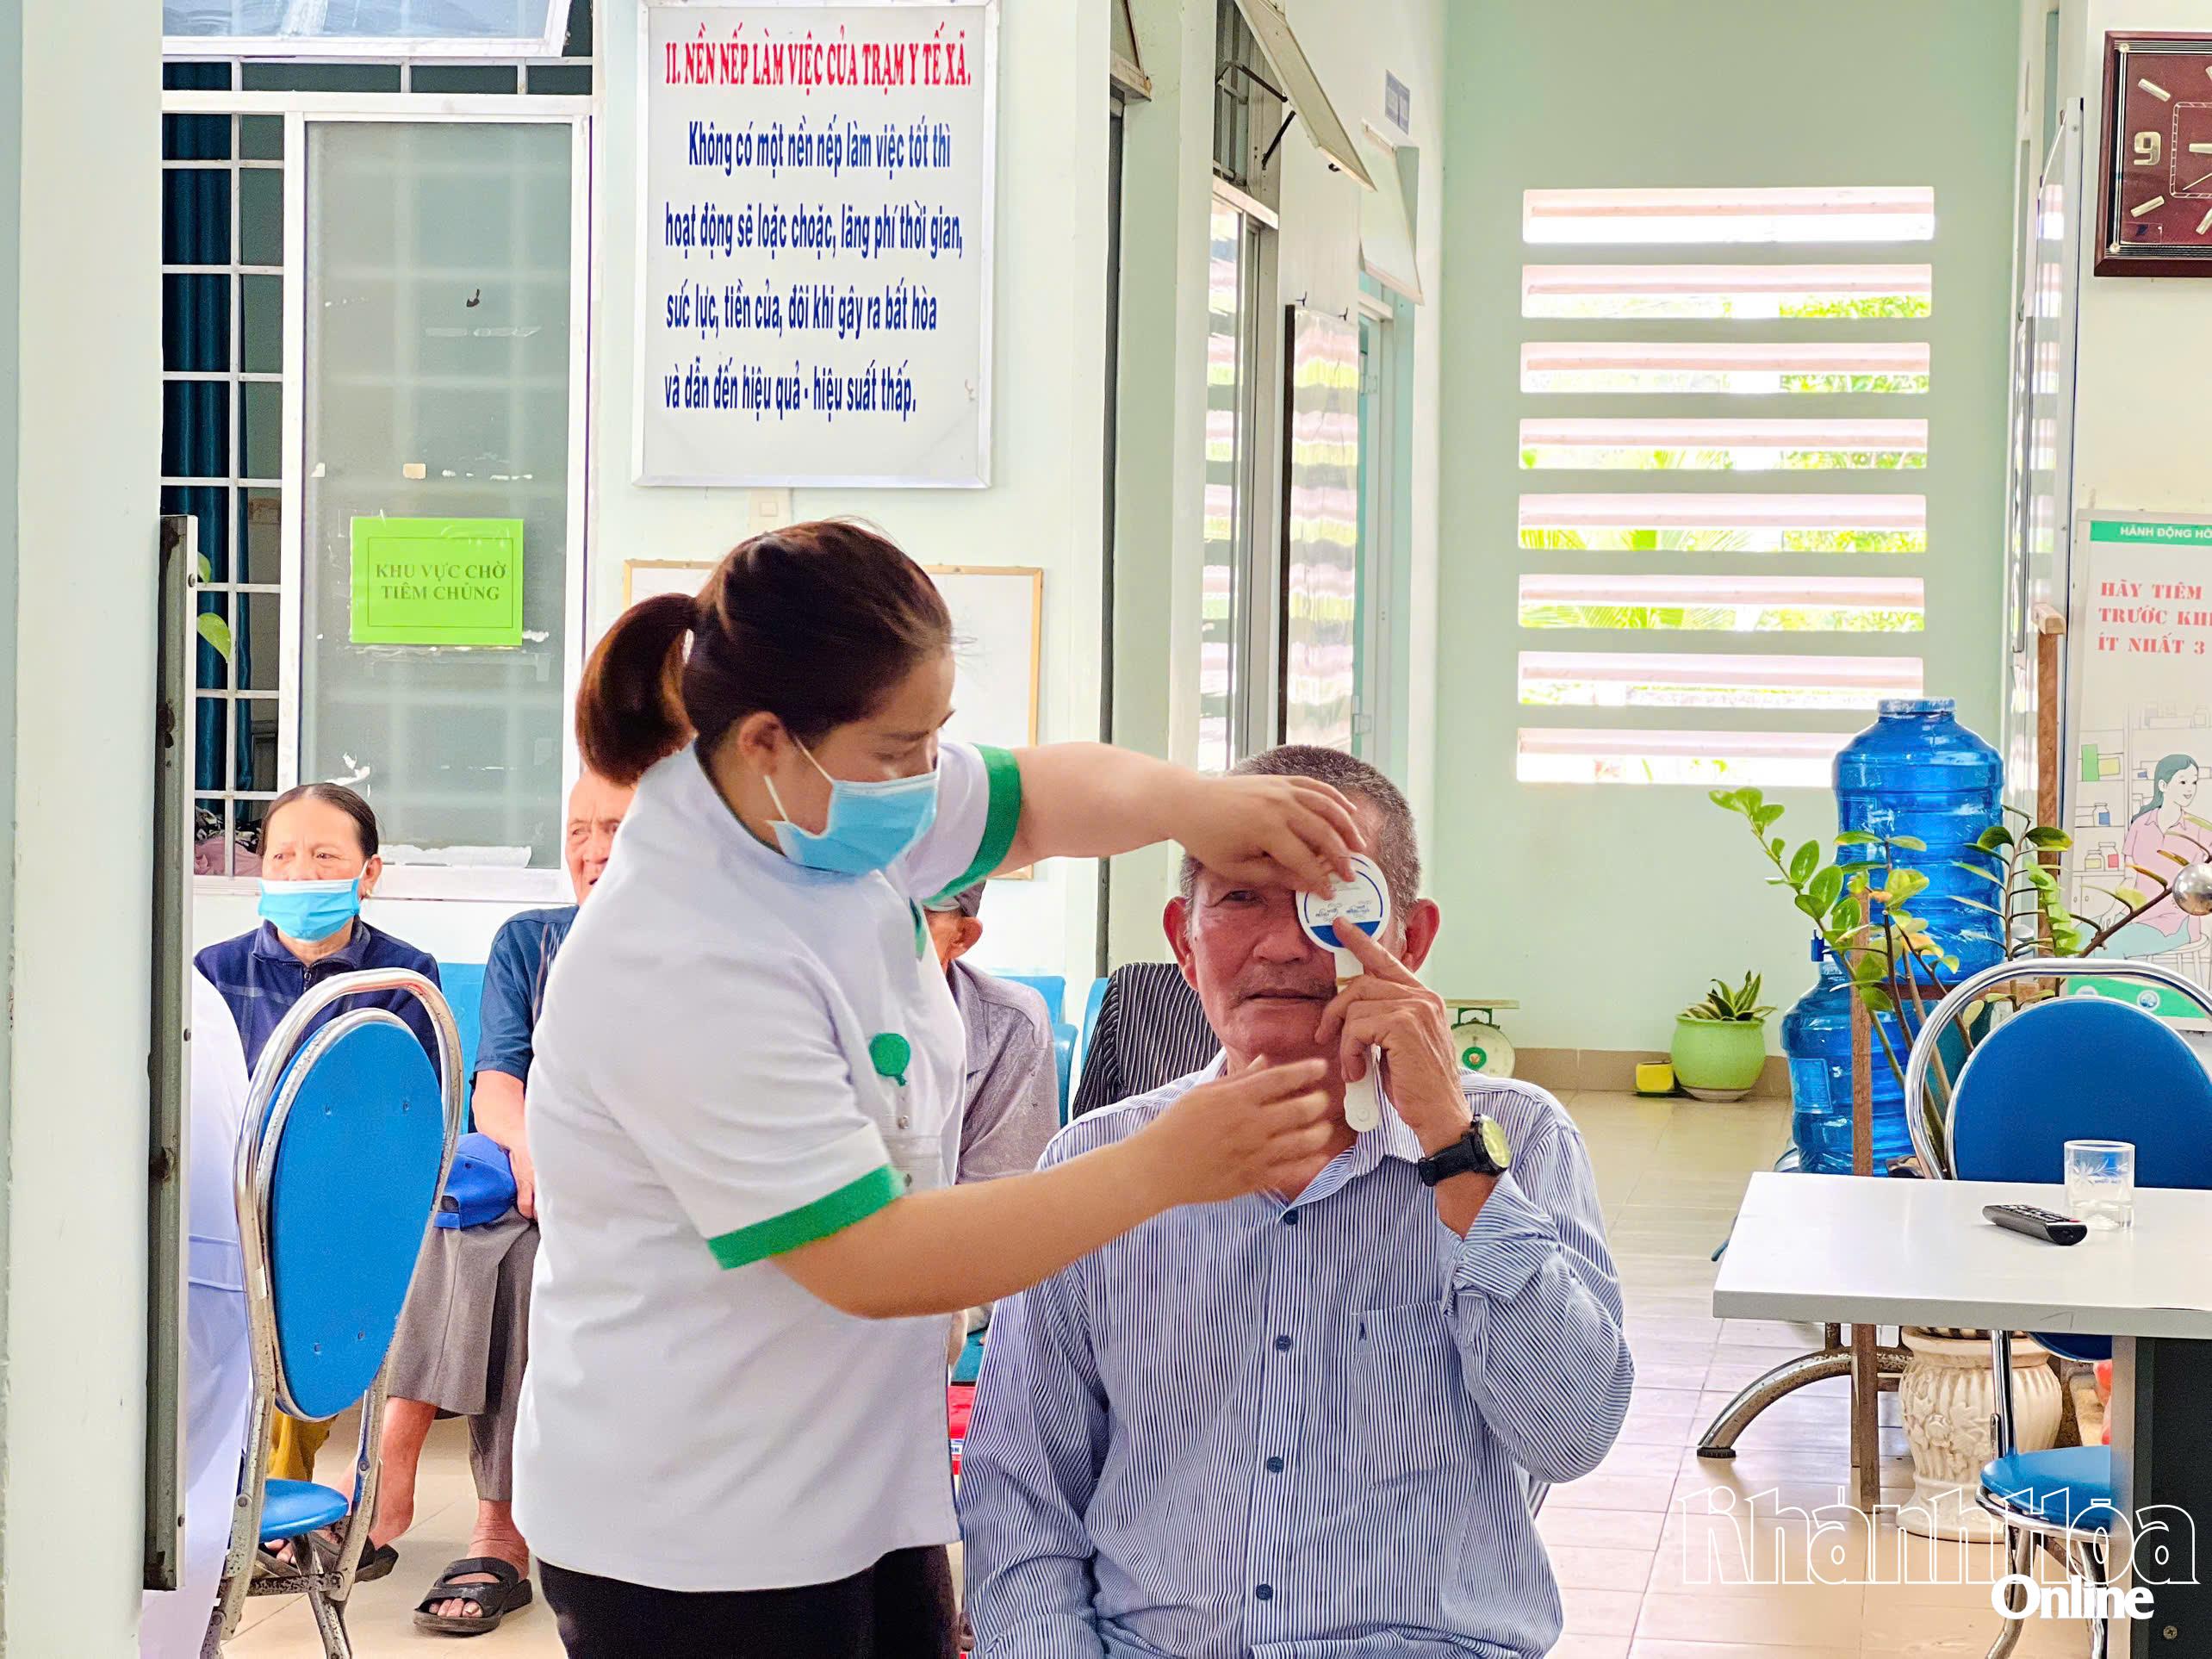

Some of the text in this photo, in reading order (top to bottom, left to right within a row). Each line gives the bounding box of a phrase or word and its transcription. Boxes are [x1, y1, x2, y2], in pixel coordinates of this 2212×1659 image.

[666, 22, 971, 96] II. NỀN NẾP LÀM VIỆC CỦA TRẠM Y TẾ XÃ.
[689, 114, 950, 179] Không có một nền nếp làm việc tốt thì
[2134, 131, 2161, 165] 9
[666, 200, 962, 260] hoạt động sẽ loặc choặc, lãng phí thời gian,
[667, 277, 936, 339] sức lực, tiền của, đôi khi gây ra bất hòa
[665, 363, 679, 408] và
[685, 356, 708, 408] dẫn
[714, 357, 737, 408] đến
[743, 364, 771, 421] hiệu
[776, 360, 799, 420] quả
[814, 366, 842, 422] hiệu
[847, 359, 876, 411] suất
[882, 359, 916, 421] thấp.
[376, 561, 506, 581] KHU VỰC CHỜ
[382, 582, 427, 600] TIÊM
[2101, 579, 2202, 600] HÃY TIÊM
[2099, 605, 2167, 624] TRƯỚC
[2098, 632, 2205, 655] ÍT NHẤT 3
